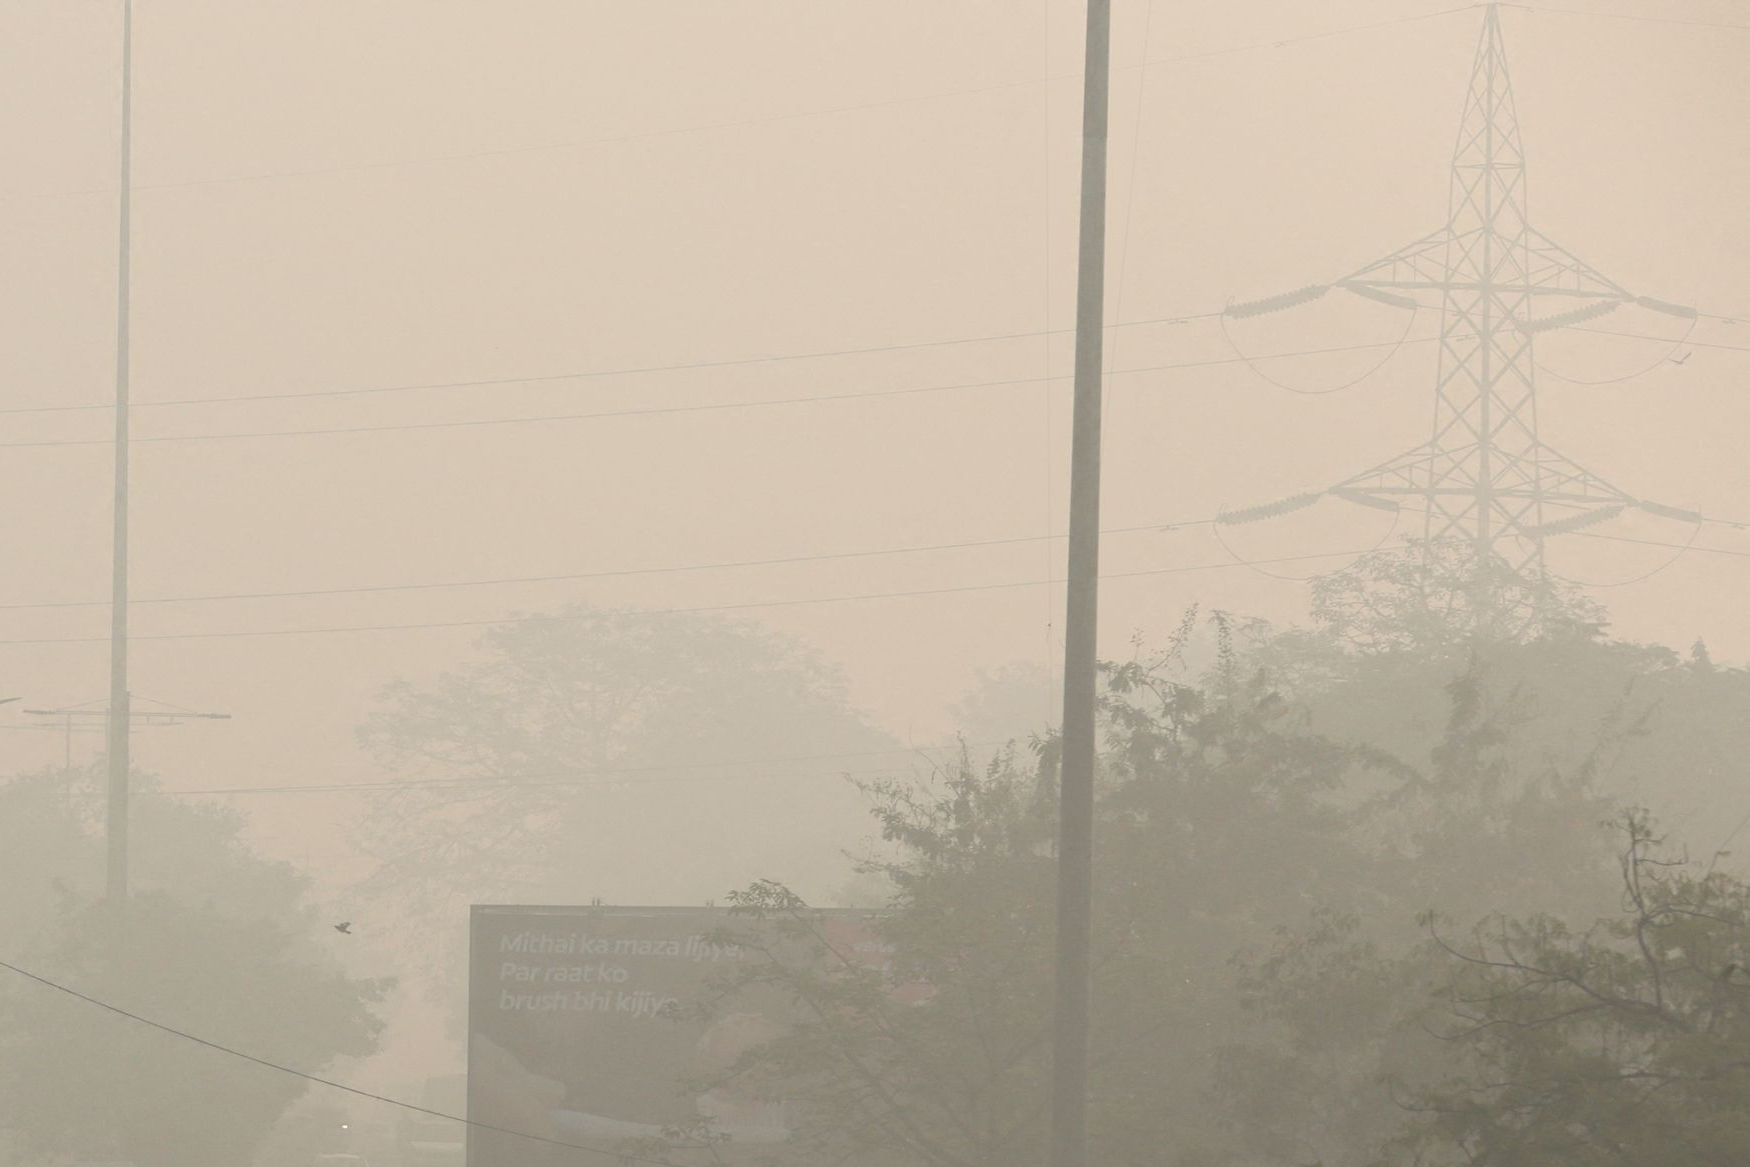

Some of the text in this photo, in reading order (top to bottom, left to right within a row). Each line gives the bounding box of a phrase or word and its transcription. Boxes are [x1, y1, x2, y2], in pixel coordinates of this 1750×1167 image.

[499, 933, 576, 954] Mithai
[579, 935, 609, 954] ka
[613, 939, 678, 956] maza
[499, 961, 628, 983] Par raat ko
[498, 990, 568, 1011] brush
[571, 990, 612, 1011] bhi
